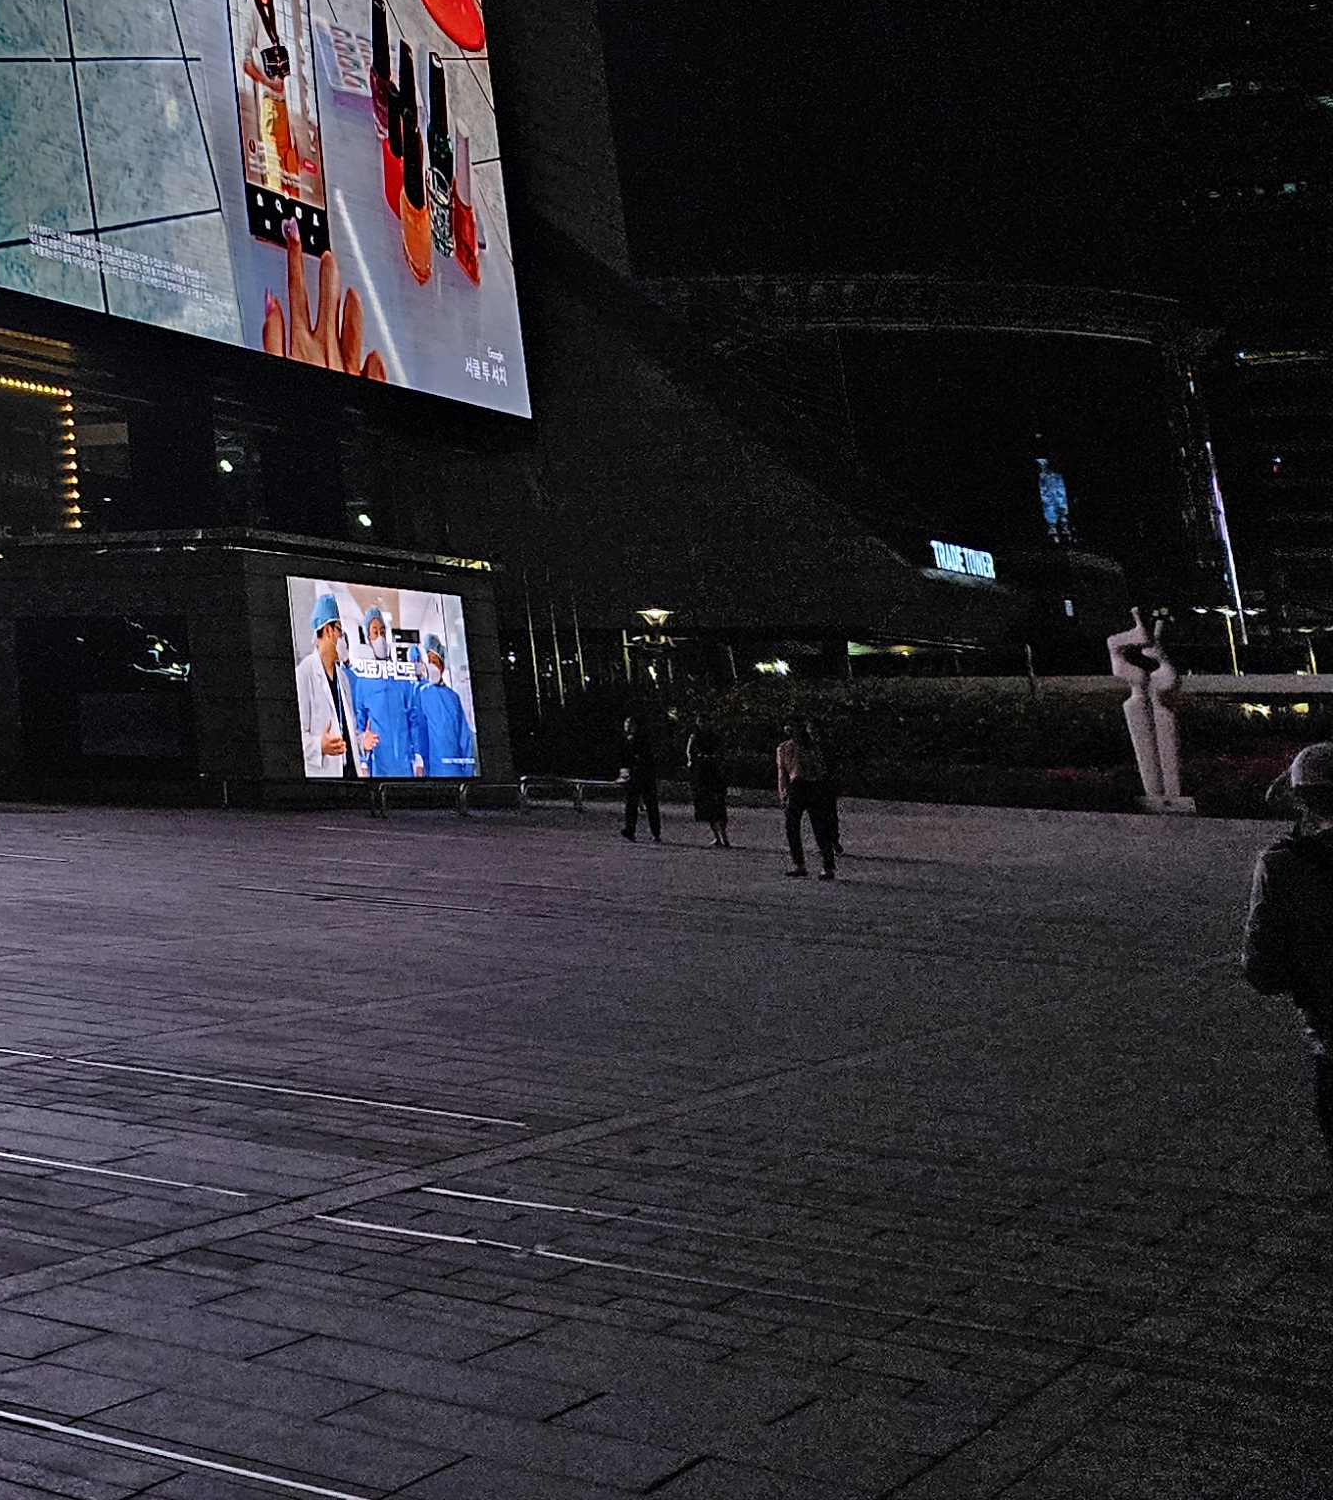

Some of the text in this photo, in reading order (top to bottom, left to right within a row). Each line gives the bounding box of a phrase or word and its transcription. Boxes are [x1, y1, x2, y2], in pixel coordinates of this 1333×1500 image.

[465, 357, 508, 388] 서클 투 서치
[930, 539, 996, 579] TRADE TOWER
[357, 658, 418, 681] 의료개혁으로
